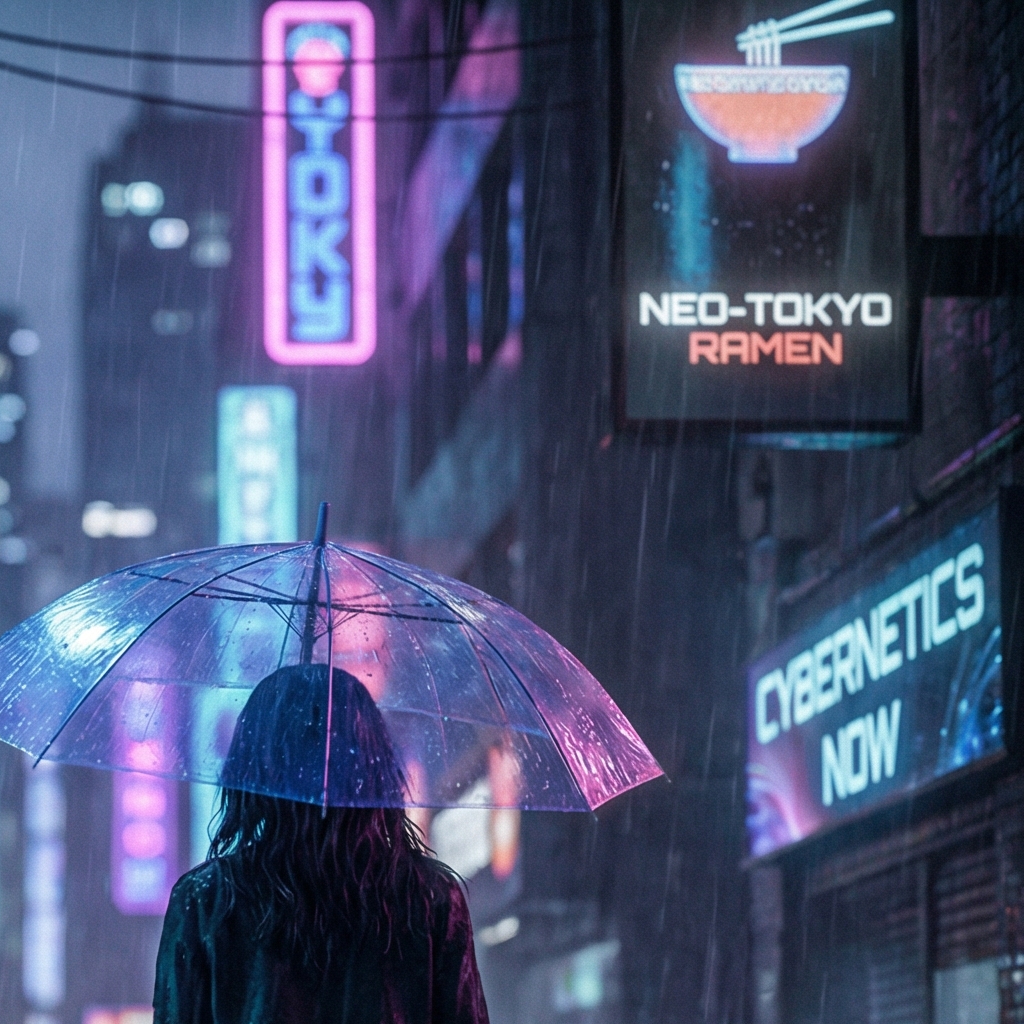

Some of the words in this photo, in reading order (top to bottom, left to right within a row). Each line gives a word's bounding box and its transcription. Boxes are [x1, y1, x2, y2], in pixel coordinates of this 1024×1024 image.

[638, 292, 893, 327] NEO-TOKYO
[688, 330, 844, 366] RAMEN
[755, 543, 985, 745] CYBERNETICS
[821, 698, 902, 807] NOW
